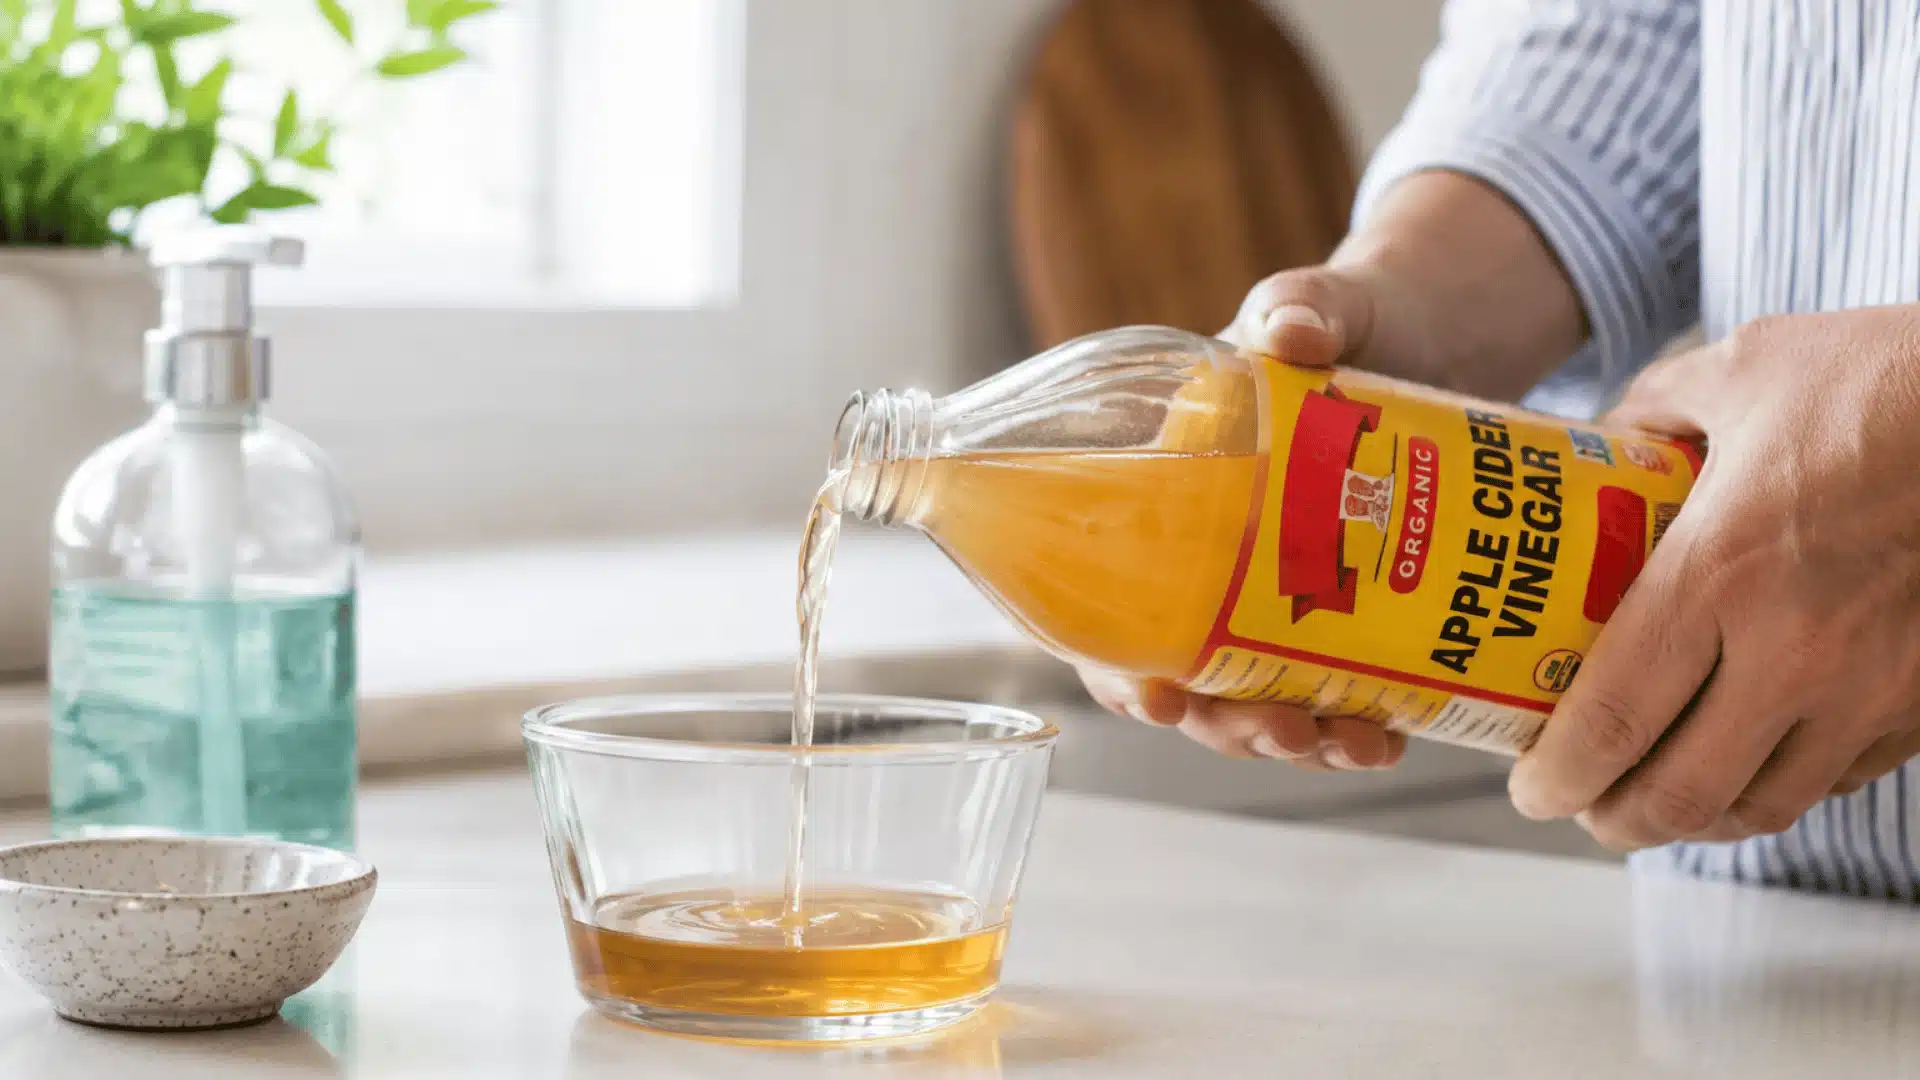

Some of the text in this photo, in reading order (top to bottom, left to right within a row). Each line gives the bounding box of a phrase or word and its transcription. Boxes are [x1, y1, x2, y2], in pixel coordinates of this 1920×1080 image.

[1399, 448, 1432, 578] ORGANIC
[1465, 408, 1513, 519] CIDER
[1430, 528, 1509, 674] APPLE
[1493, 446, 1562, 637] VINEGAR
